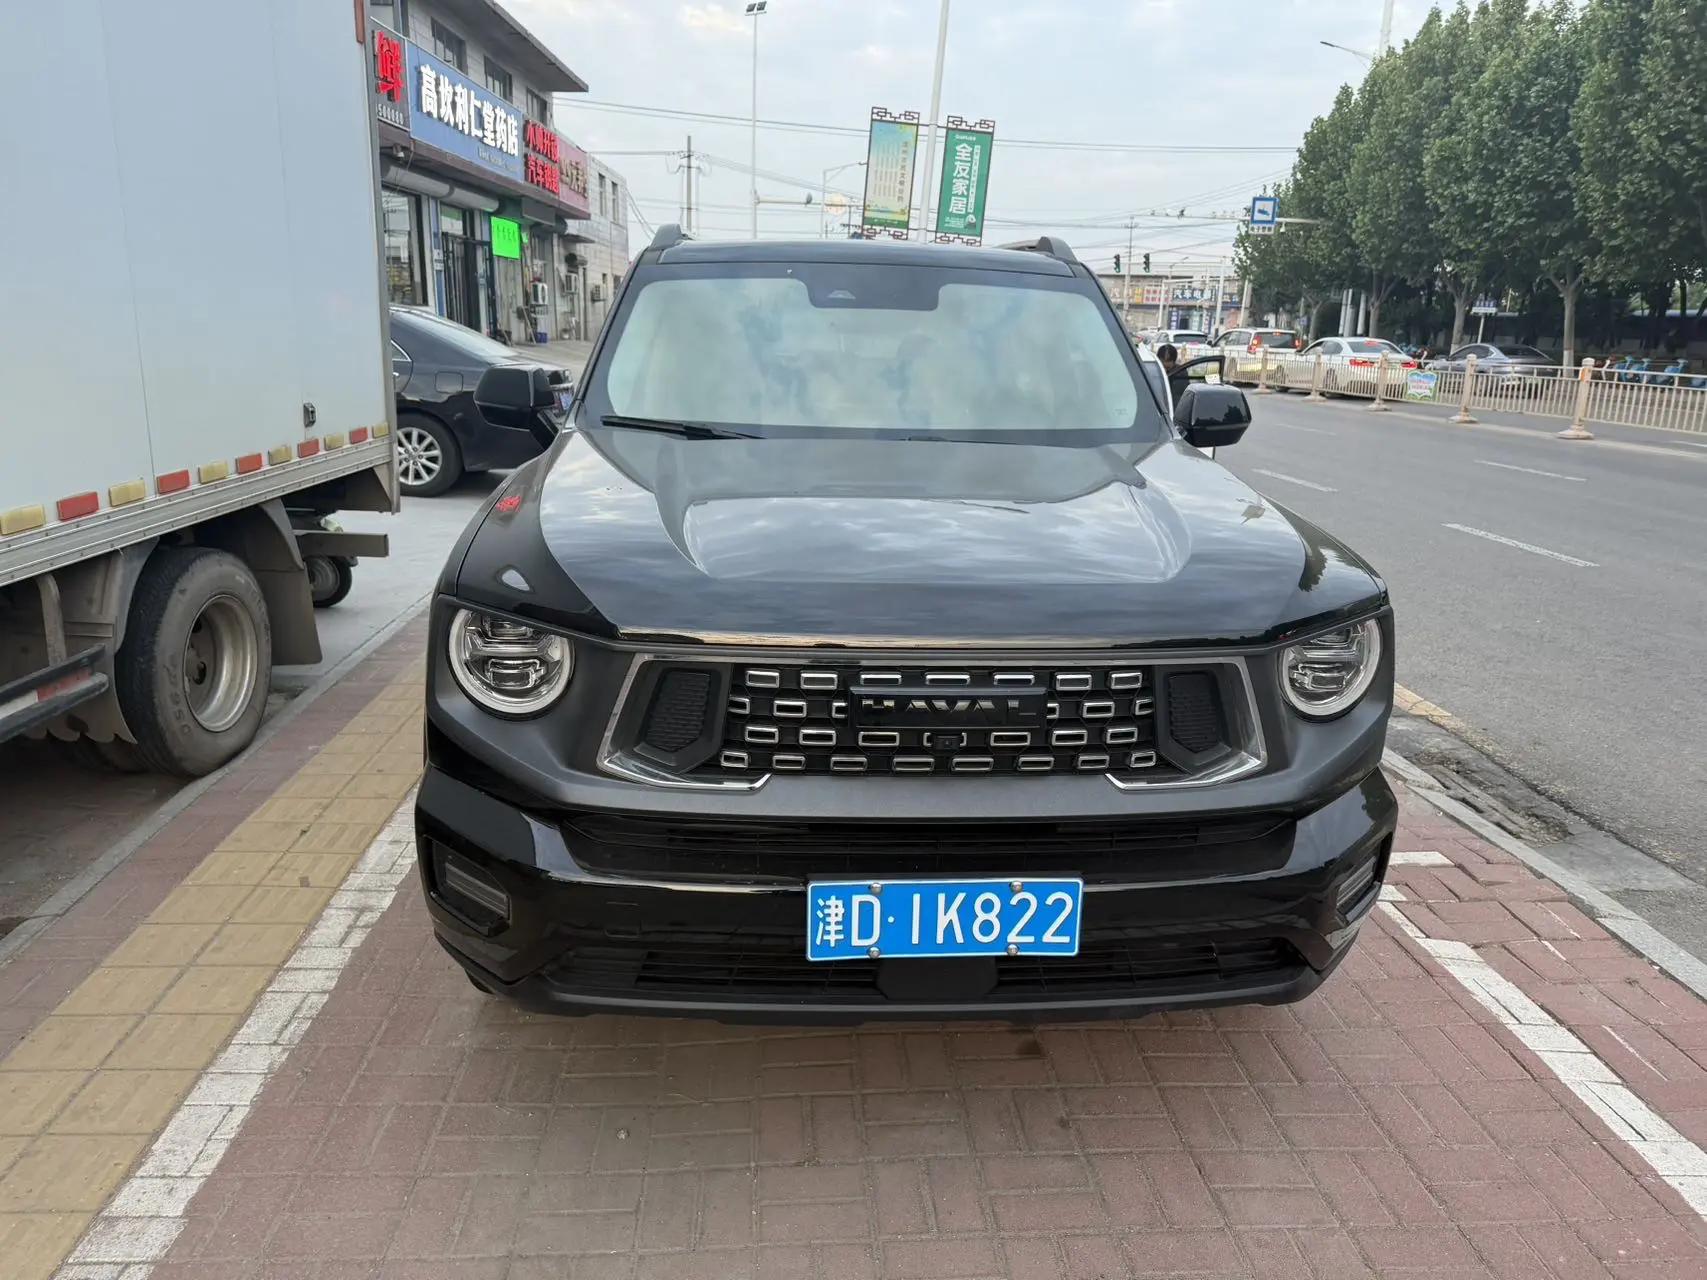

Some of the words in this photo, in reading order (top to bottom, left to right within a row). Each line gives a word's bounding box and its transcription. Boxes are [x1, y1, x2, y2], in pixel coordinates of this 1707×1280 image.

[949, 143, 973, 214] 全友家居
[815, 891, 1074, 947] 津D·1K822
